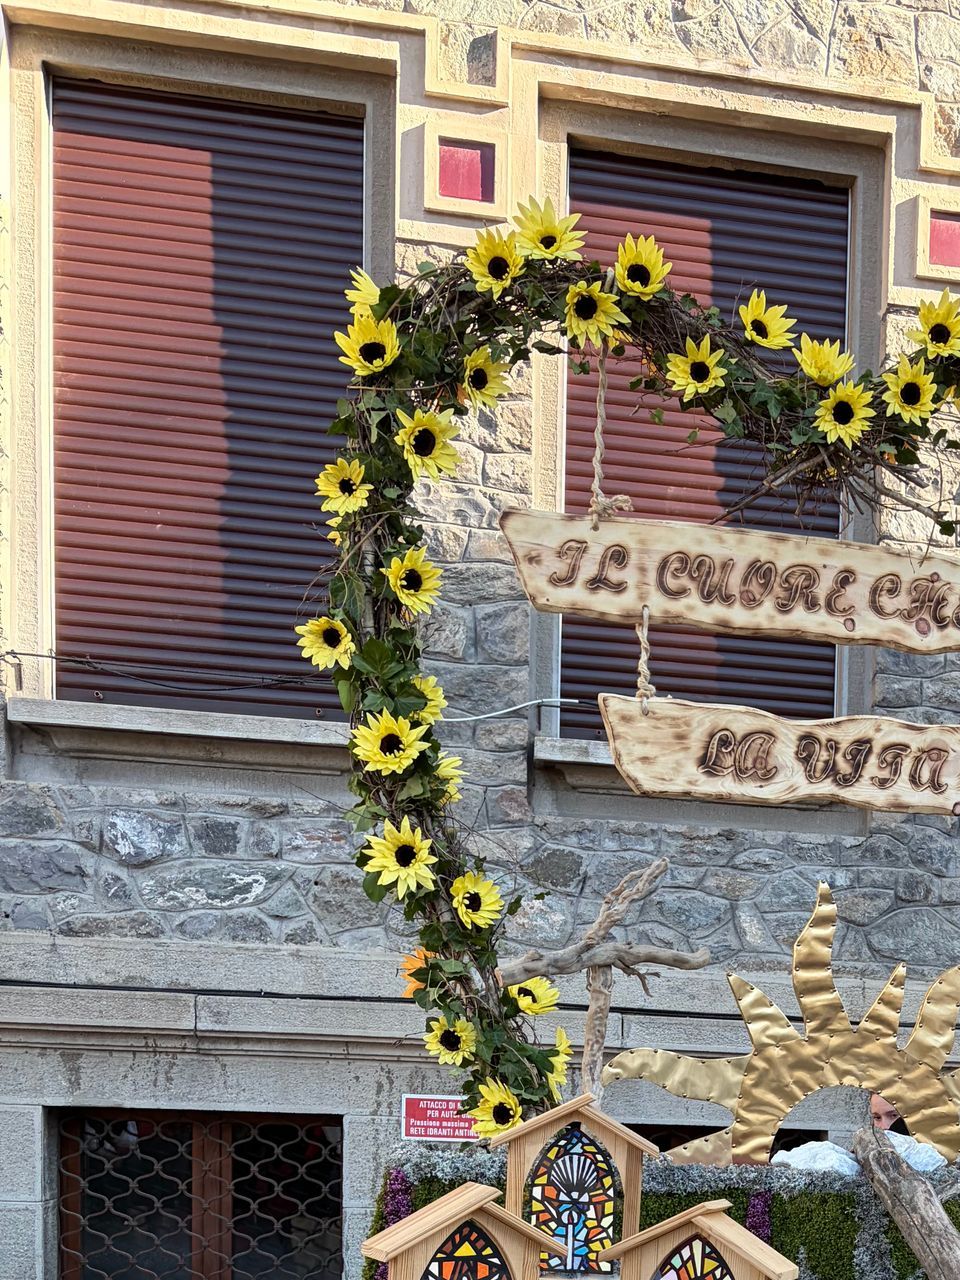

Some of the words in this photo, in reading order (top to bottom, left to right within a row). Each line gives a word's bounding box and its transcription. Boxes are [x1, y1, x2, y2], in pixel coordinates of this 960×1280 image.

[550, 539, 628, 592] IL
[656, 551, 856, 616] CUORE
[697, 728, 778, 780] LA
[796, 735, 949, 794] VITA
[419, 1101, 447, 1109] ATTACCO
[427, 1110, 439, 1118] PER
[410, 1118, 440, 1127] Pressione
[441, 1120, 469, 1128] massima
[410, 1127, 425, 1135] RETE
[427, 1128, 454, 1136] IDRANTI
